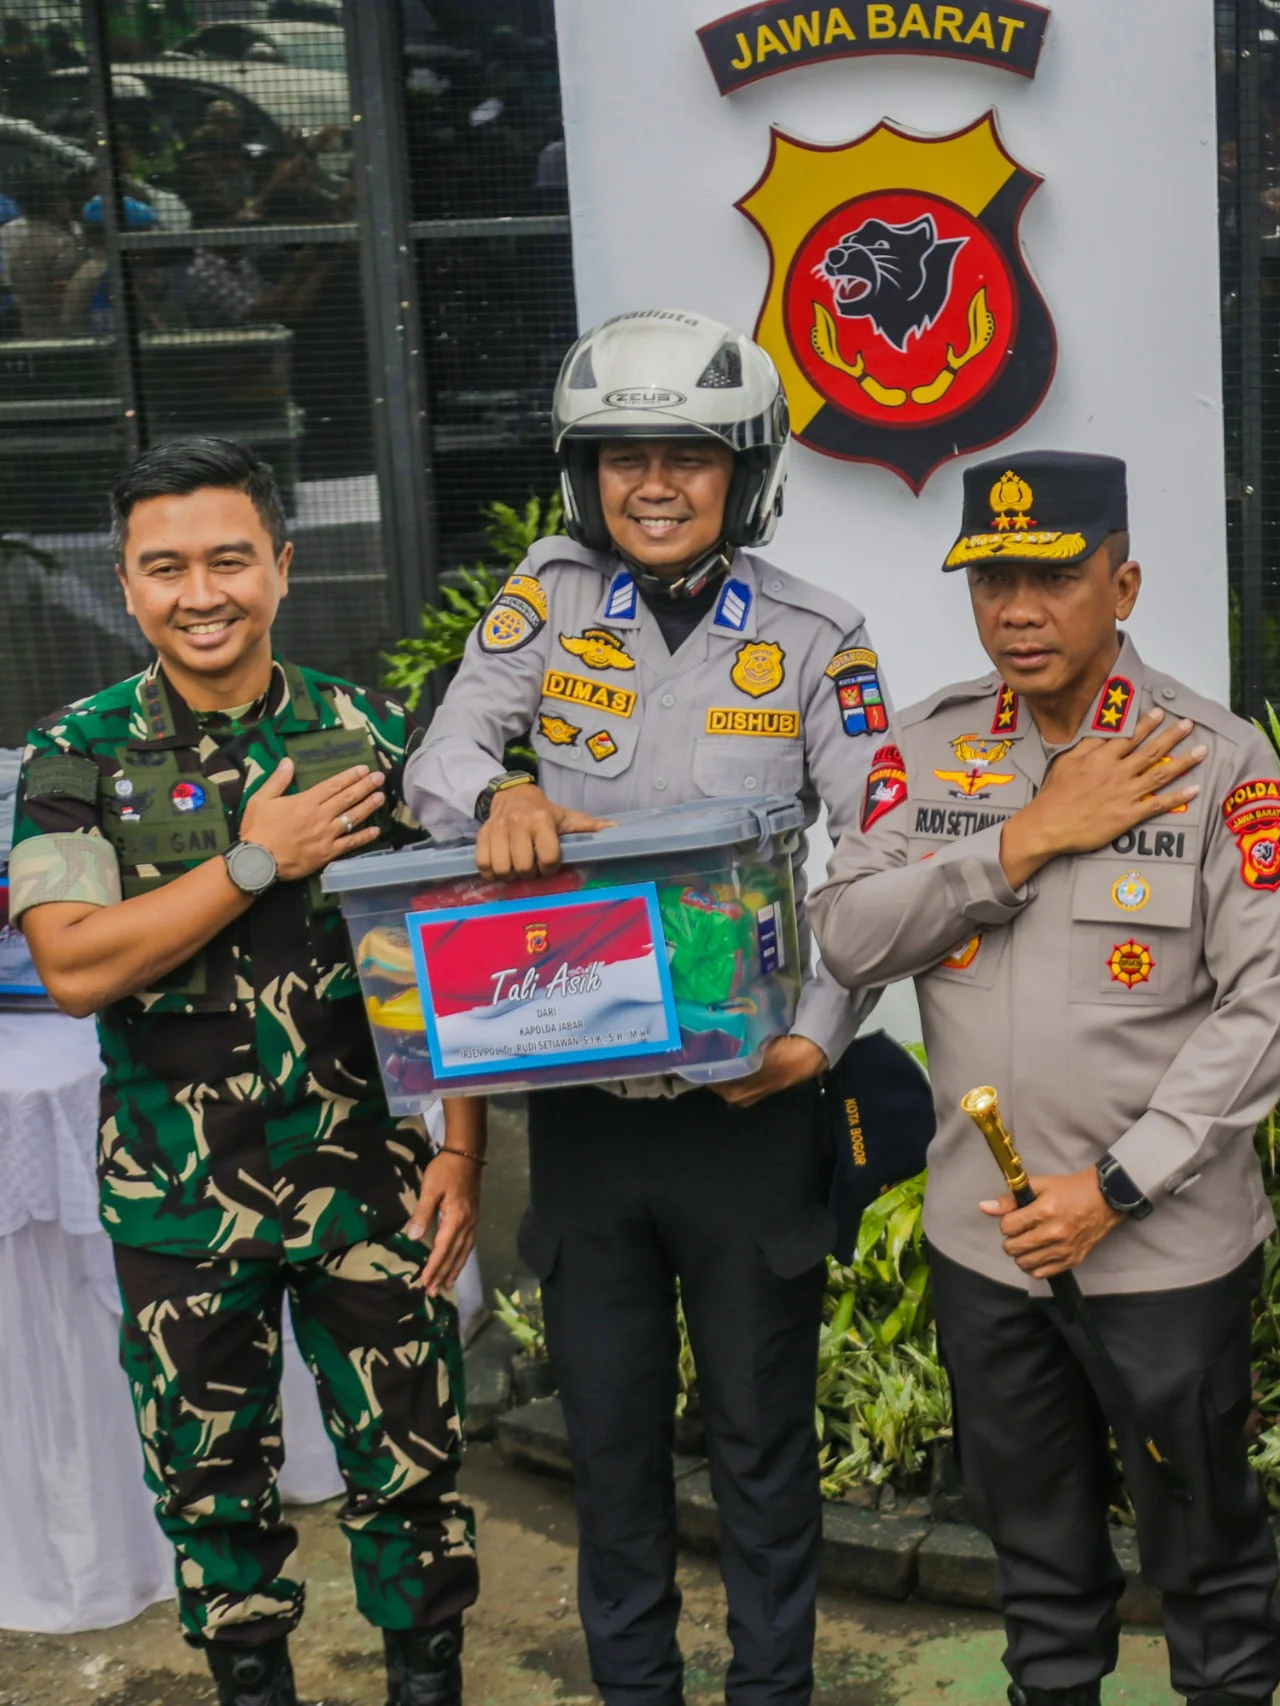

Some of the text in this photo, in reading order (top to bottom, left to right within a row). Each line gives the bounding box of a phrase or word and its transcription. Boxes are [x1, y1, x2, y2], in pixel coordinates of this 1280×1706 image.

[730, 3, 1025, 70] JAWA BARAT
[615, 393, 671, 402] ZEUS
[547, 674, 629, 712] DIMAS
[711, 711, 795, 733] DISHUB
[1224, 782, 1280, 813] POLDA
[915, 807, 946, 835] RUDI
[1111, 829, 1185, 859] OLRI
[490, 961, 603, 1006] Tali Asih
[519, 1020, 584, 1036] KAPOLDA JABAR
[516, 1040, 537, 1053] RUDI
[844, 1098, 867, 1167] KOTA BOGOR
